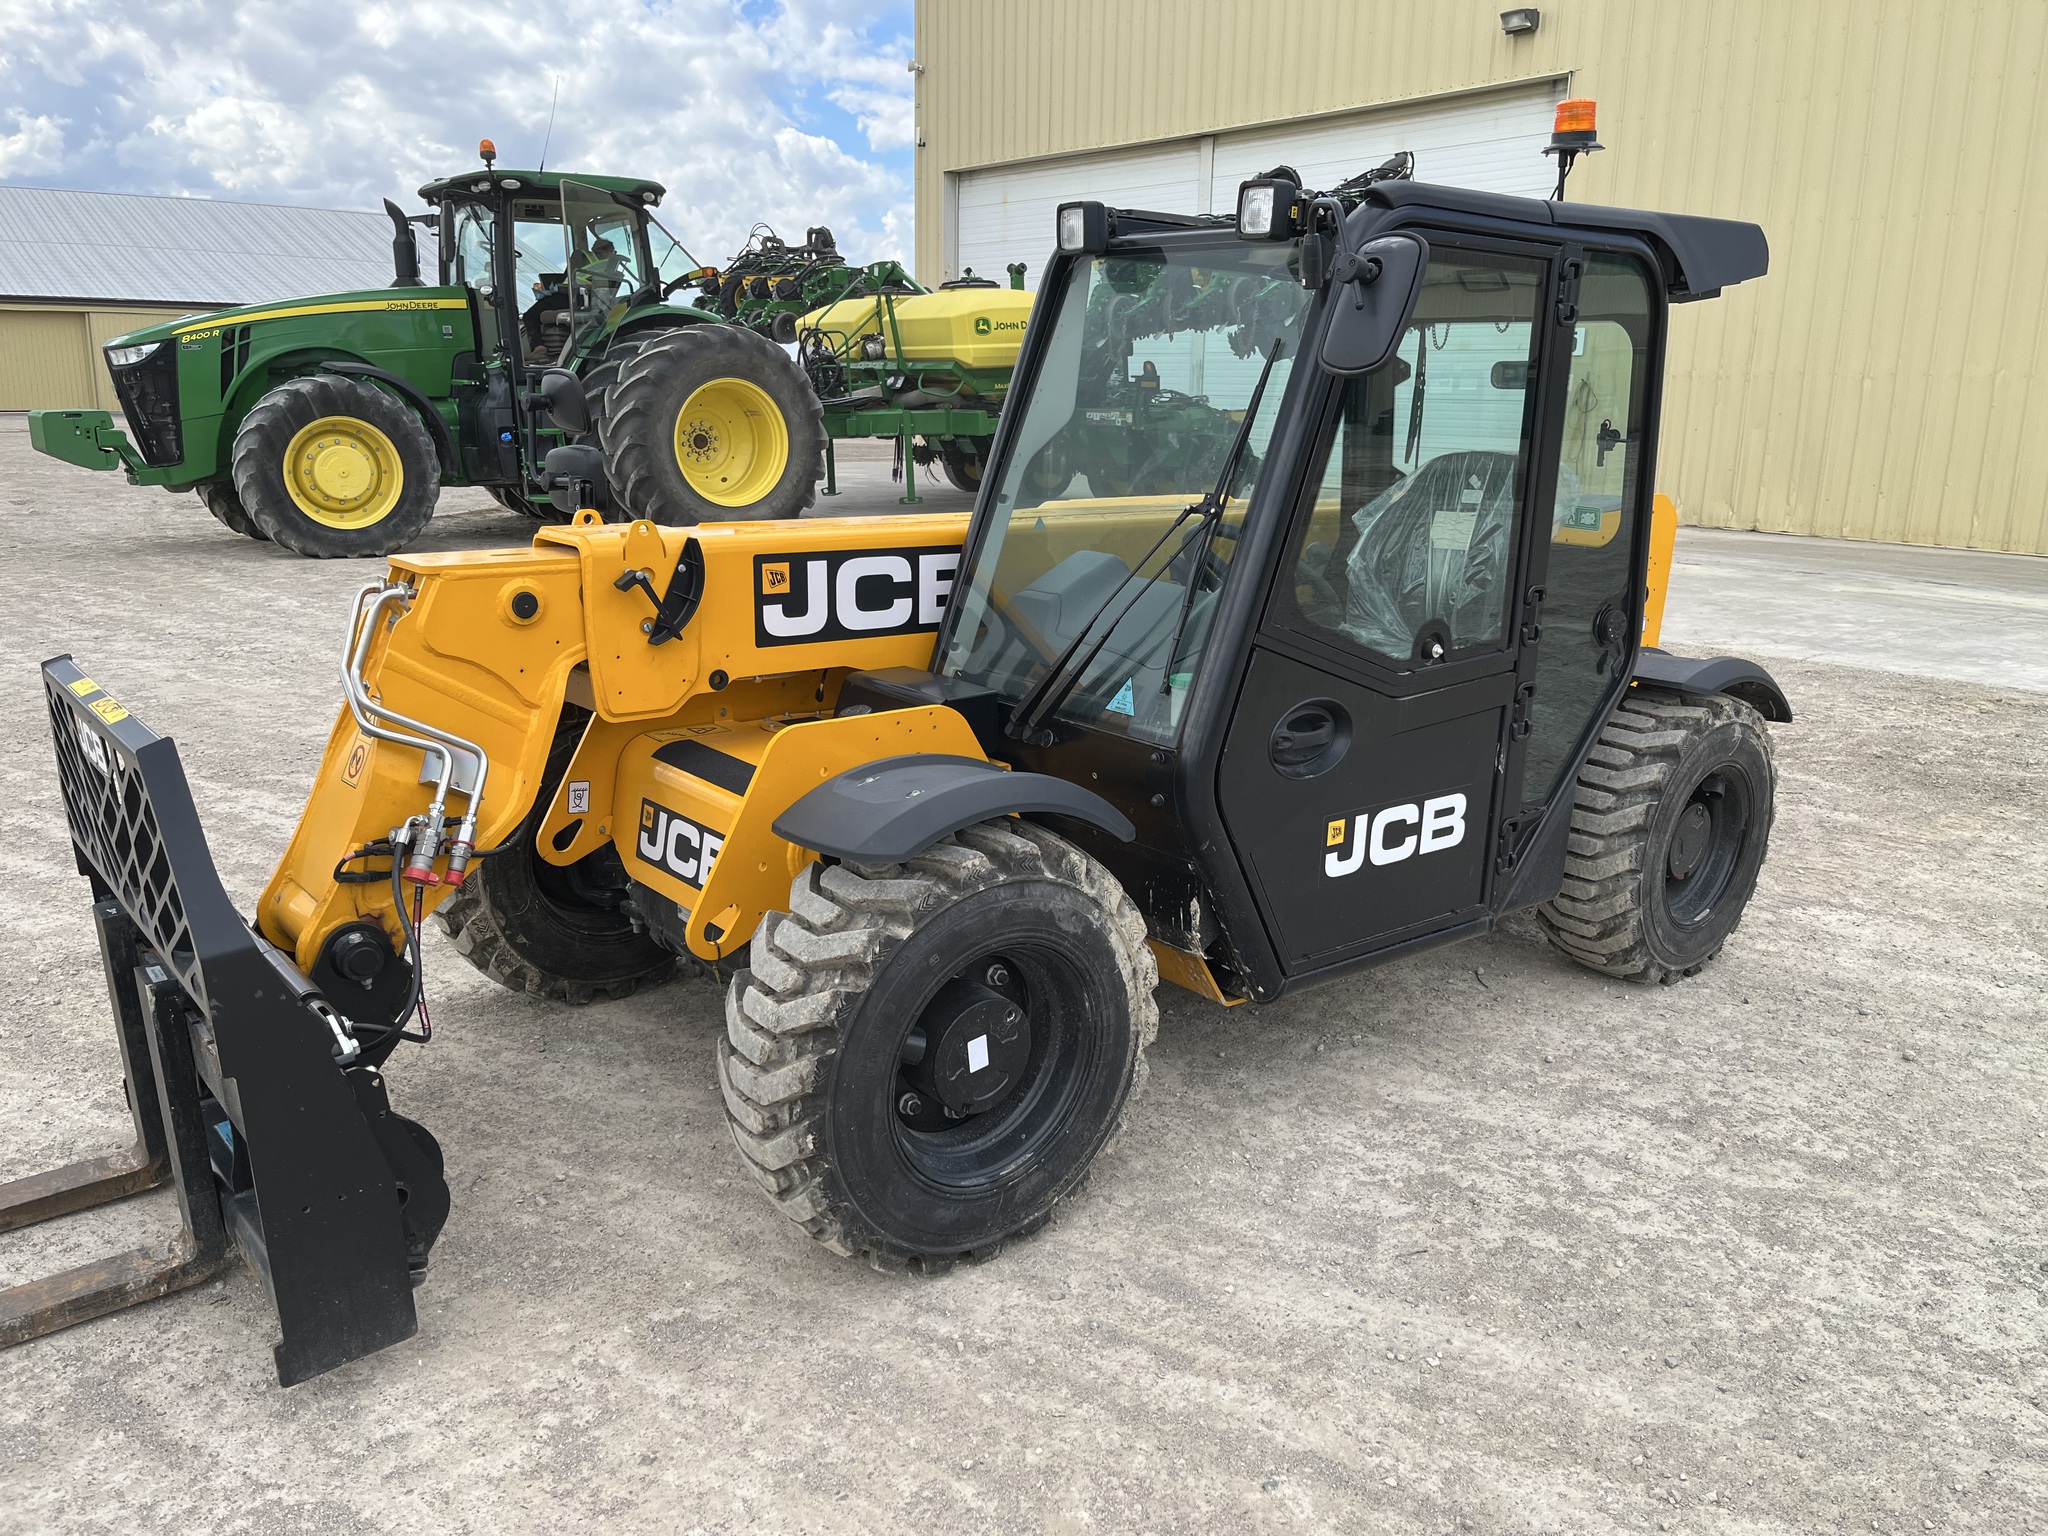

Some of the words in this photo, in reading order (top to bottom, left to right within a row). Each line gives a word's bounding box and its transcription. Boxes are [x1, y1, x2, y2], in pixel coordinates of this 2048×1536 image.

[385, 302, 409, 310] JOHN
[409, 301, 439, 309] DEERE
[993, 321, 1019, 331] JOHN
[1020, 321, 1028, 330] D
[181, 331, 211, 343] 8400
[212, 329, 220, 337] R
[769, 571, 786, 586] JCB
[78, 717, 108, 774] JCB
[1325, 793, 1467, 878] JCB
